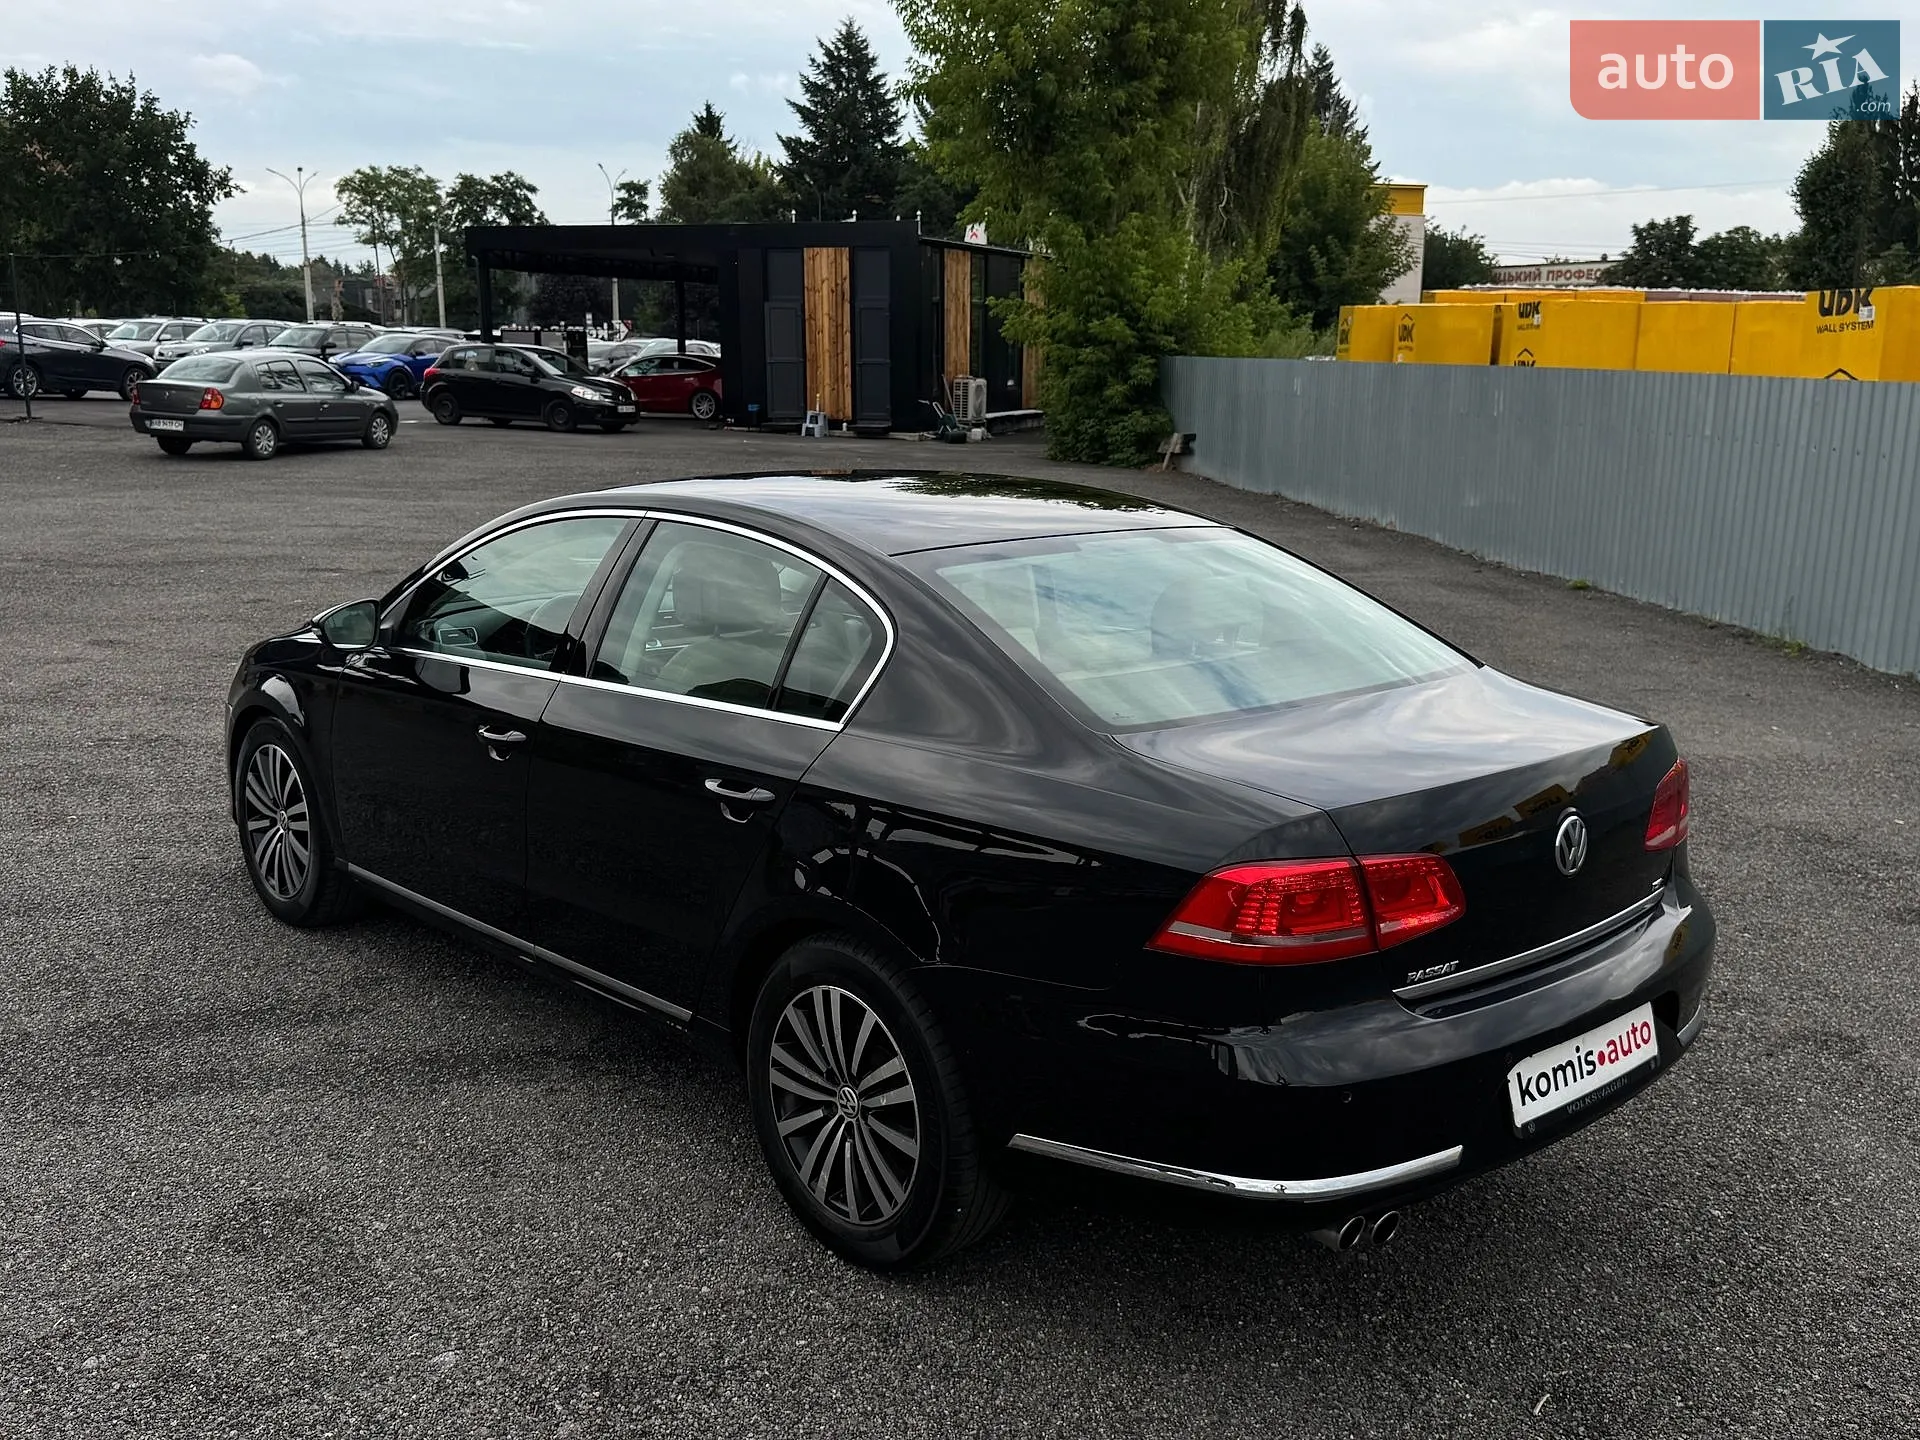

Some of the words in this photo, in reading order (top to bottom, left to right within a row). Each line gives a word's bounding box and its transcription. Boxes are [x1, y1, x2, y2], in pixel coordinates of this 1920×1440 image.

[1816, 324, 1837, 334] WALL
[1407, 960, 1459, 983] PASSAT
[1566, 1076, 1628, 1114] VOLKSWAGEN
